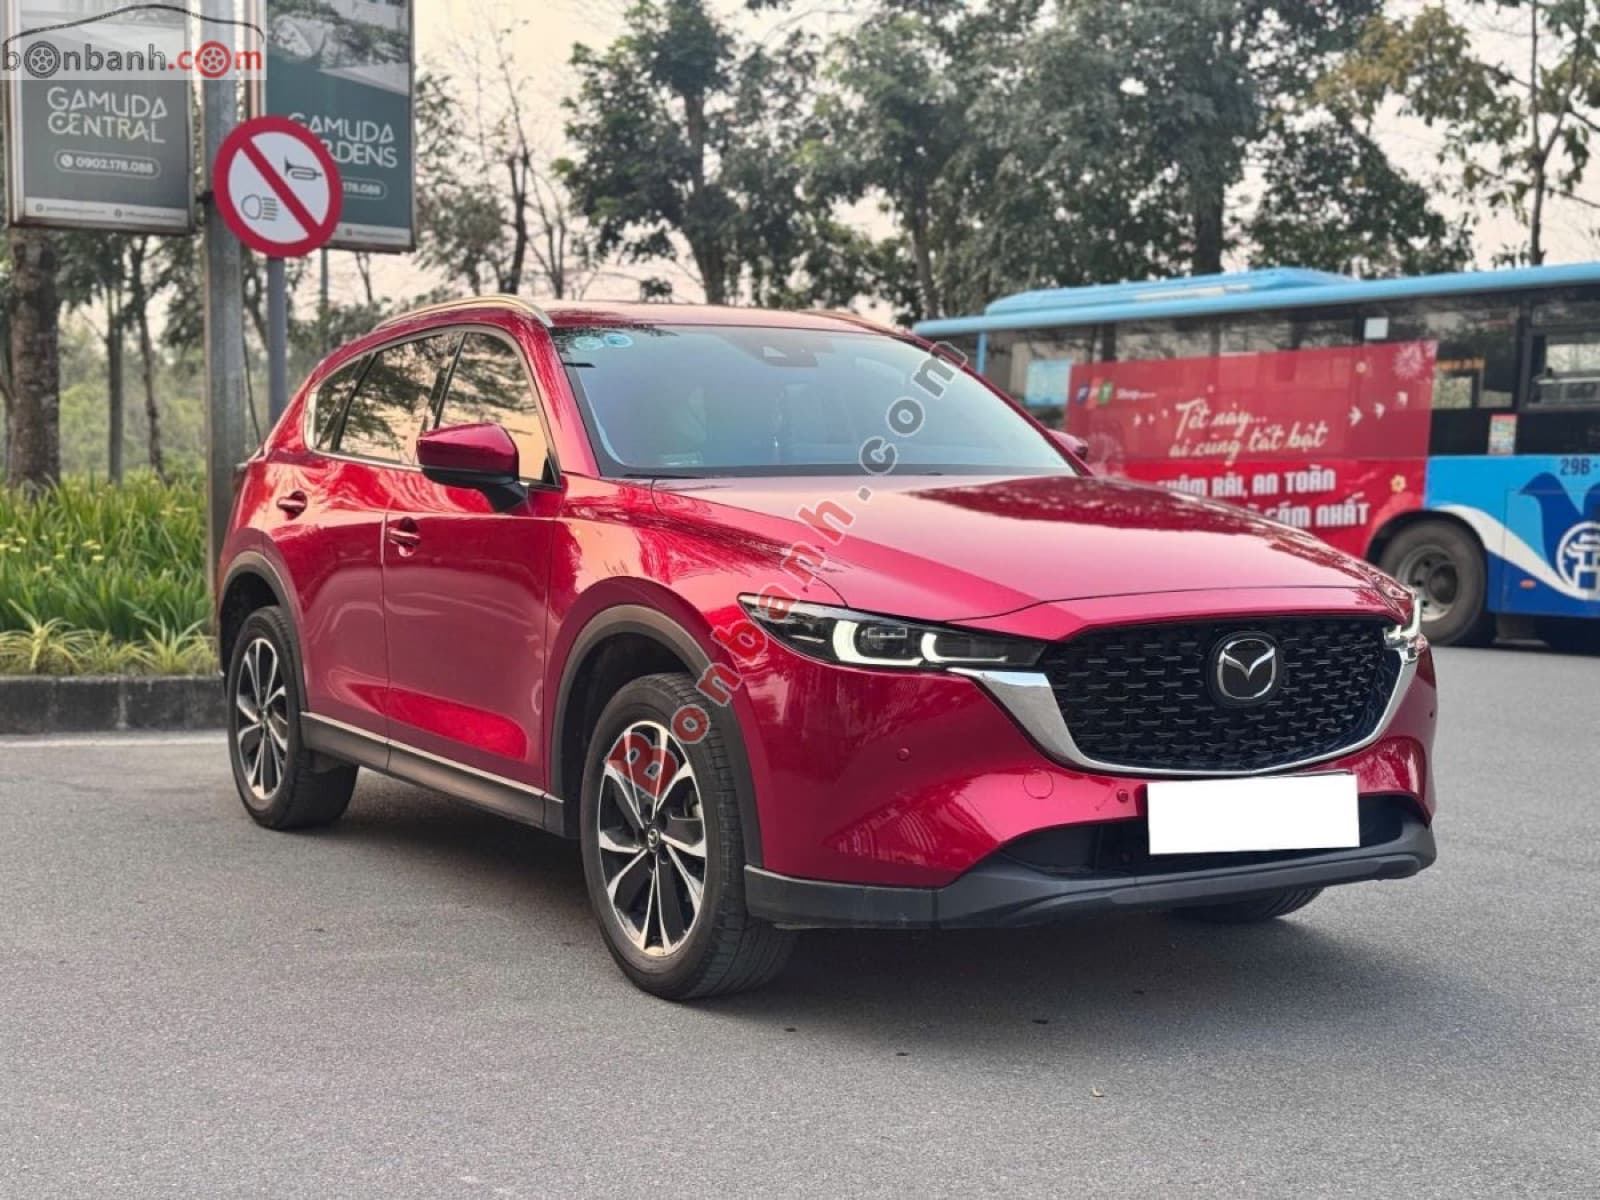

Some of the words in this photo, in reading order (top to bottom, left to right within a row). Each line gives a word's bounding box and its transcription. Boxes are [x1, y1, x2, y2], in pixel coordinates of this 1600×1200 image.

[47, 86, 168, 119] GAMUDA
[47, 111, 166, 144] CENTRAL
[321, 139, 398, 168] RDENS
[1252, 473, 1279, 495] AN
